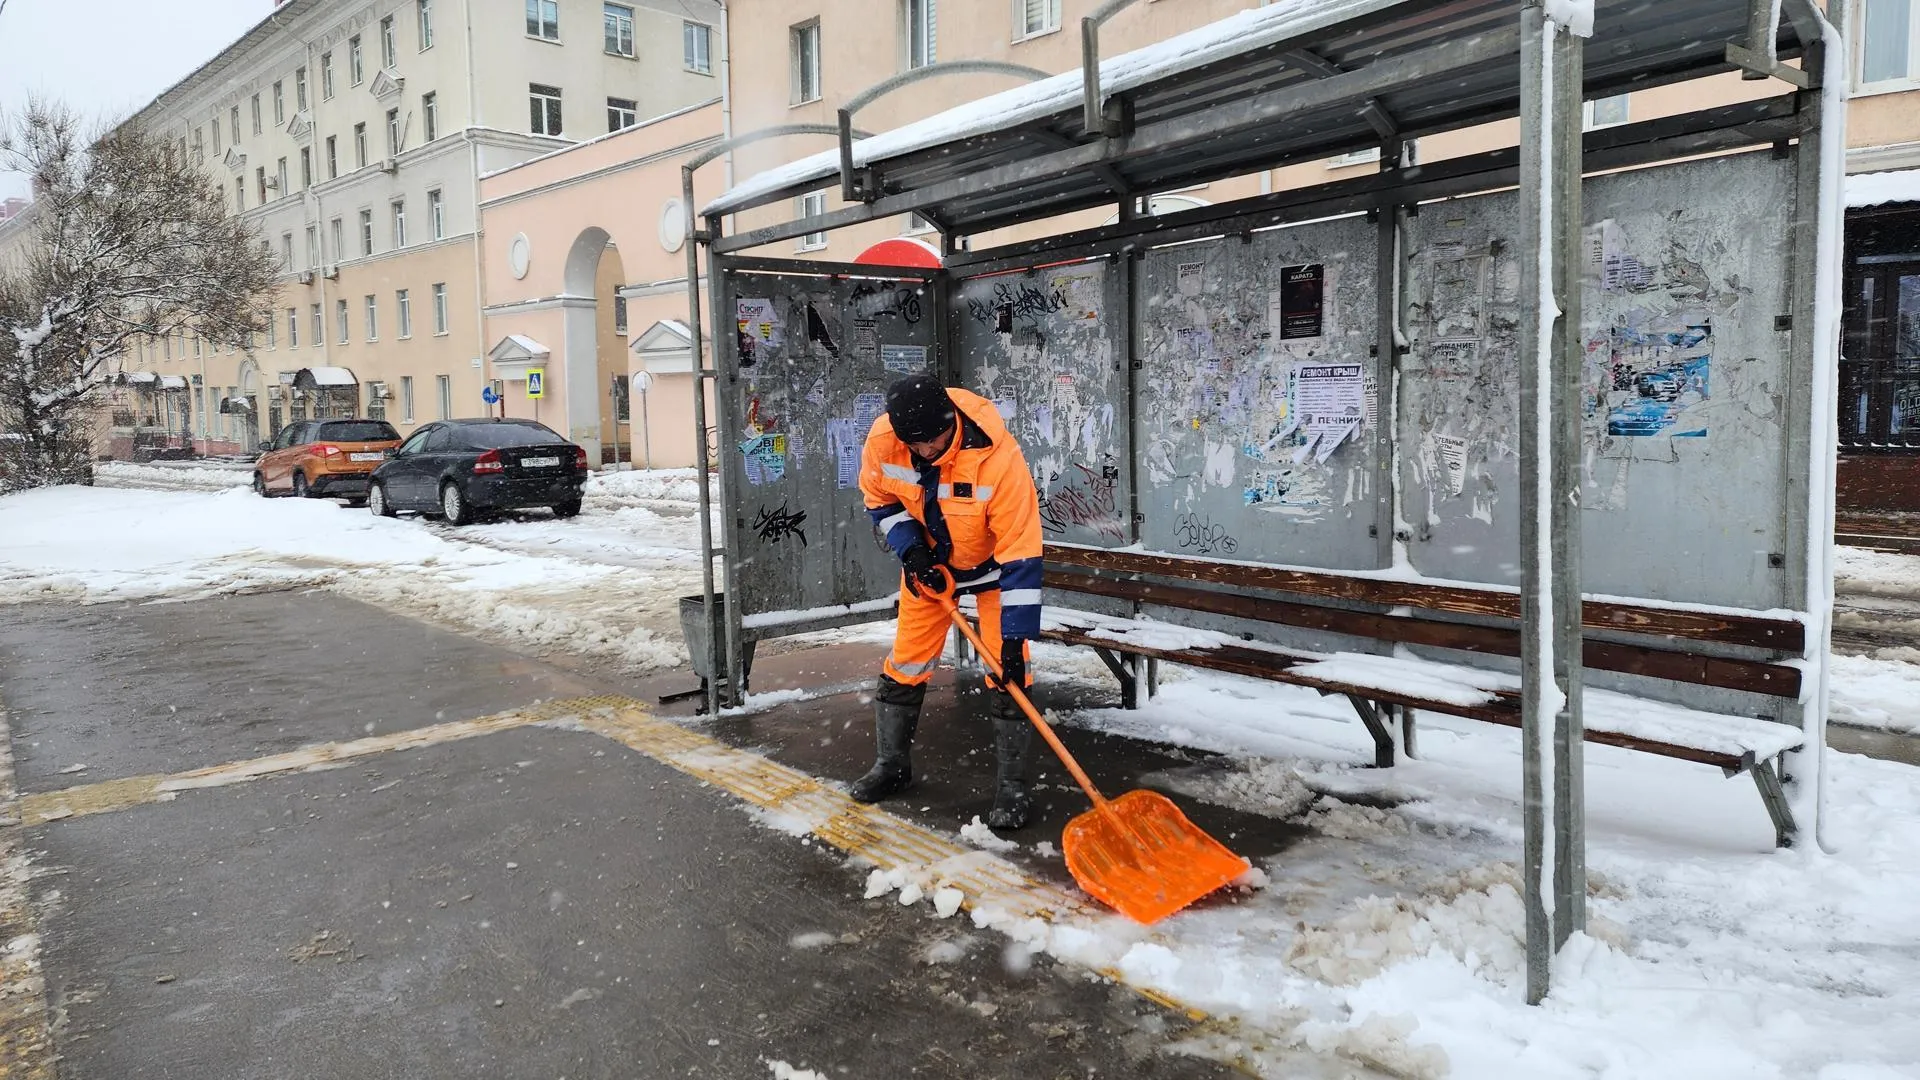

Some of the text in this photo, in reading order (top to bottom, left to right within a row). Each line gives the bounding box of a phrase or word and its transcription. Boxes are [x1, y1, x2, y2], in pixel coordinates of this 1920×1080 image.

[1290, 272, 1313, 281] КАРАТЭ
[1302, 367, 1358, 378] РЕМОНТ КРЫШ
